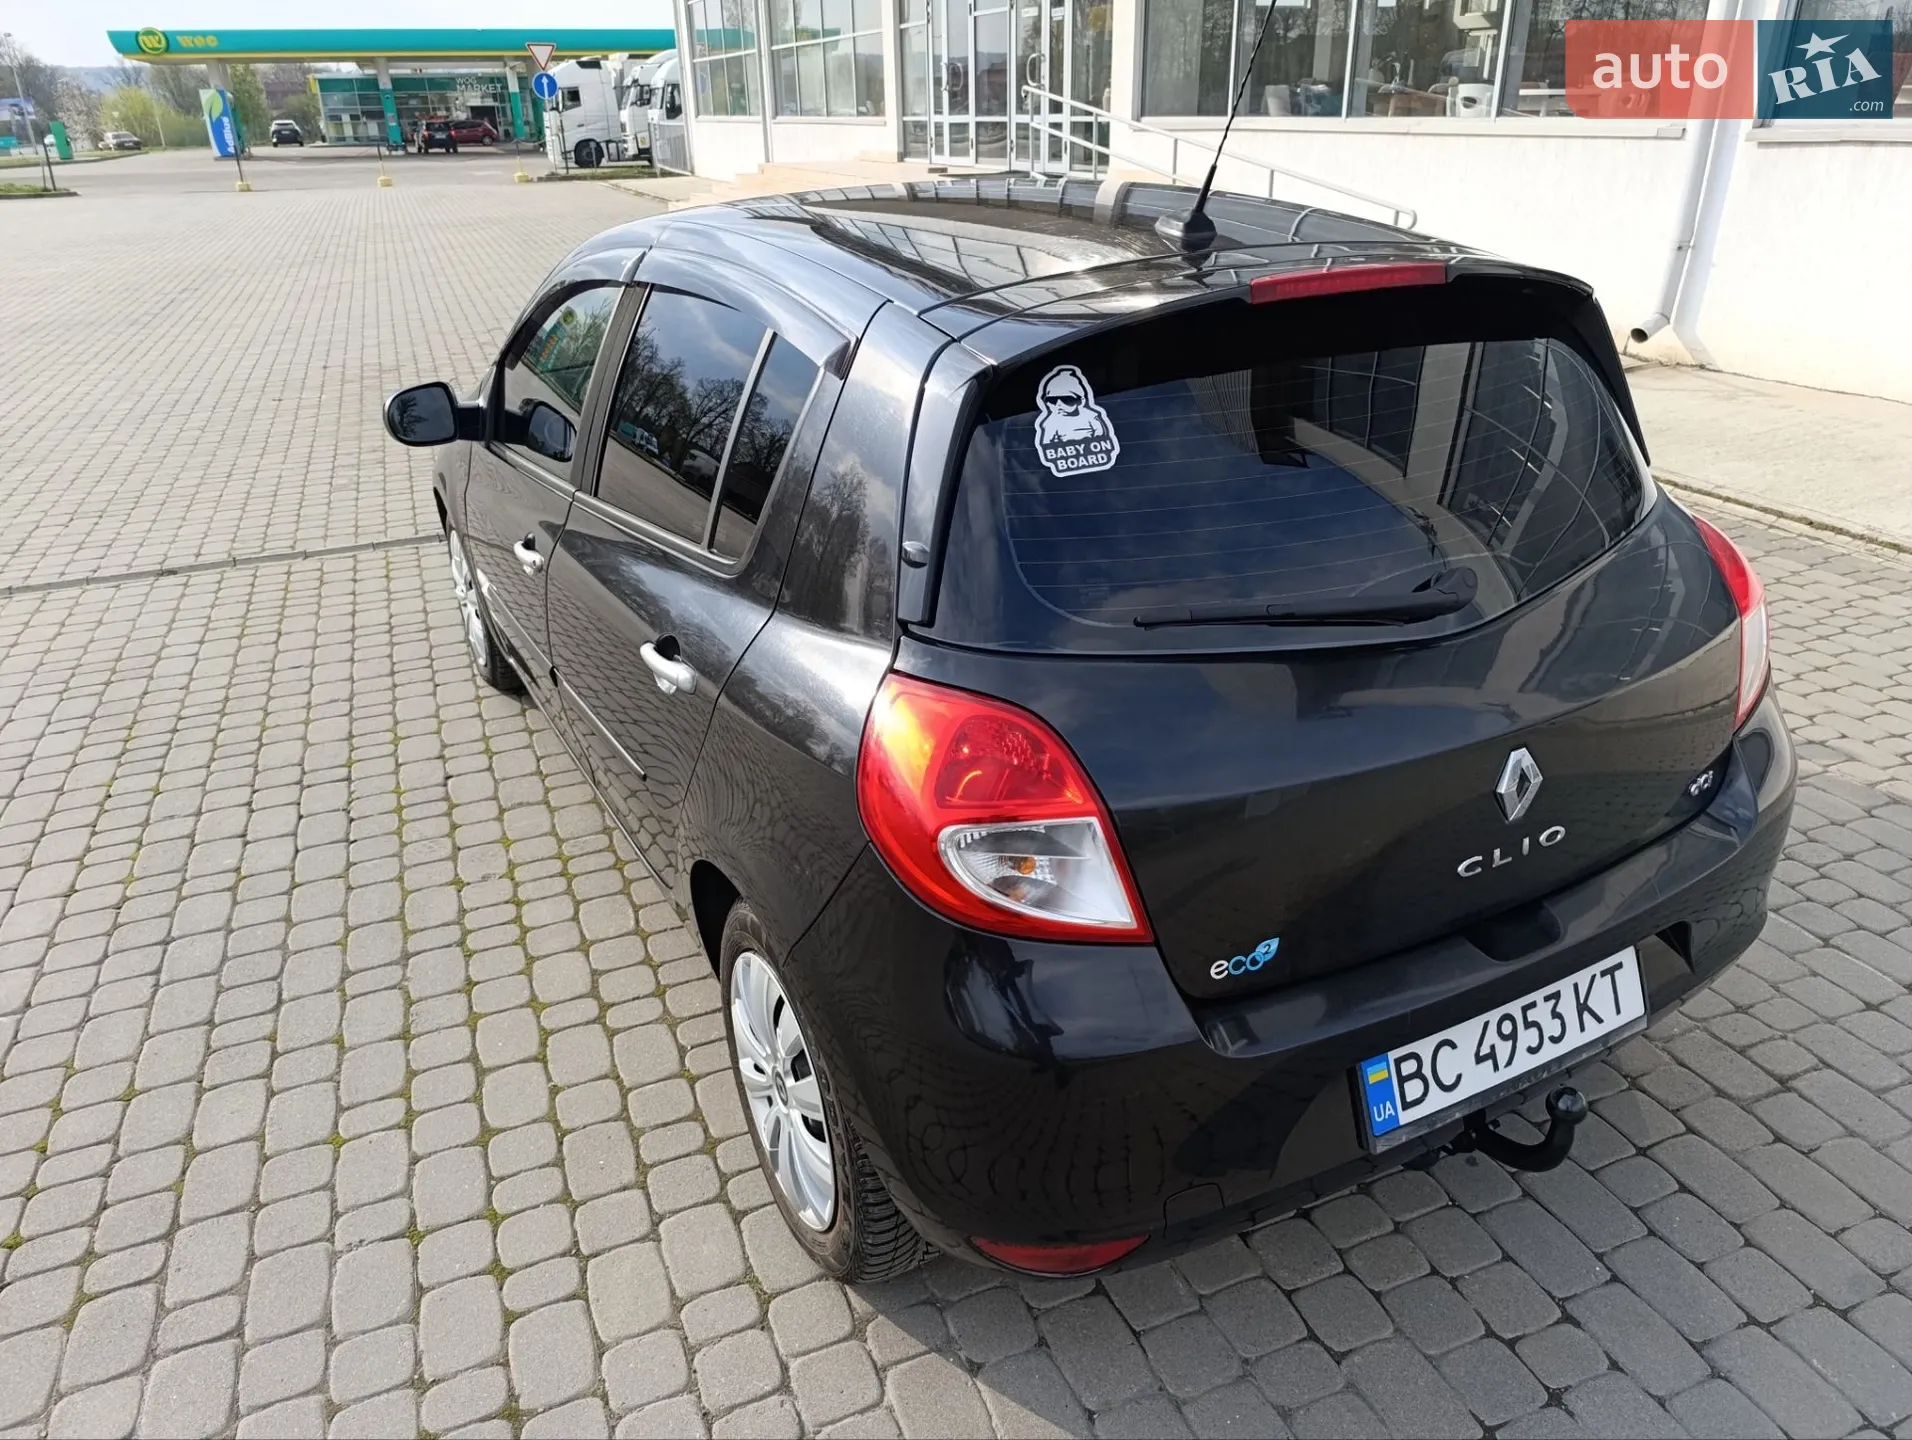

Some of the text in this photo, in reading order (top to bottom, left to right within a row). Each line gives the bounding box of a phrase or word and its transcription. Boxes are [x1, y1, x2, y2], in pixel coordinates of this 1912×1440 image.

[455, 76, 477, 84] WOG
[455, 83, 503, 94] MARKET
[1045, 439, 1112, 460] BABY ON
[1056, 453, 1108, 471] BOARD
[1457, 825, 1566, 877] CLIO
[1393, 1037, 1463, 1112] BC
[1473, 989, 1567, 1074] 4953
[1572, 960, 1624, 1033] KT
[1373, 1100, 1396, 1123] UA
